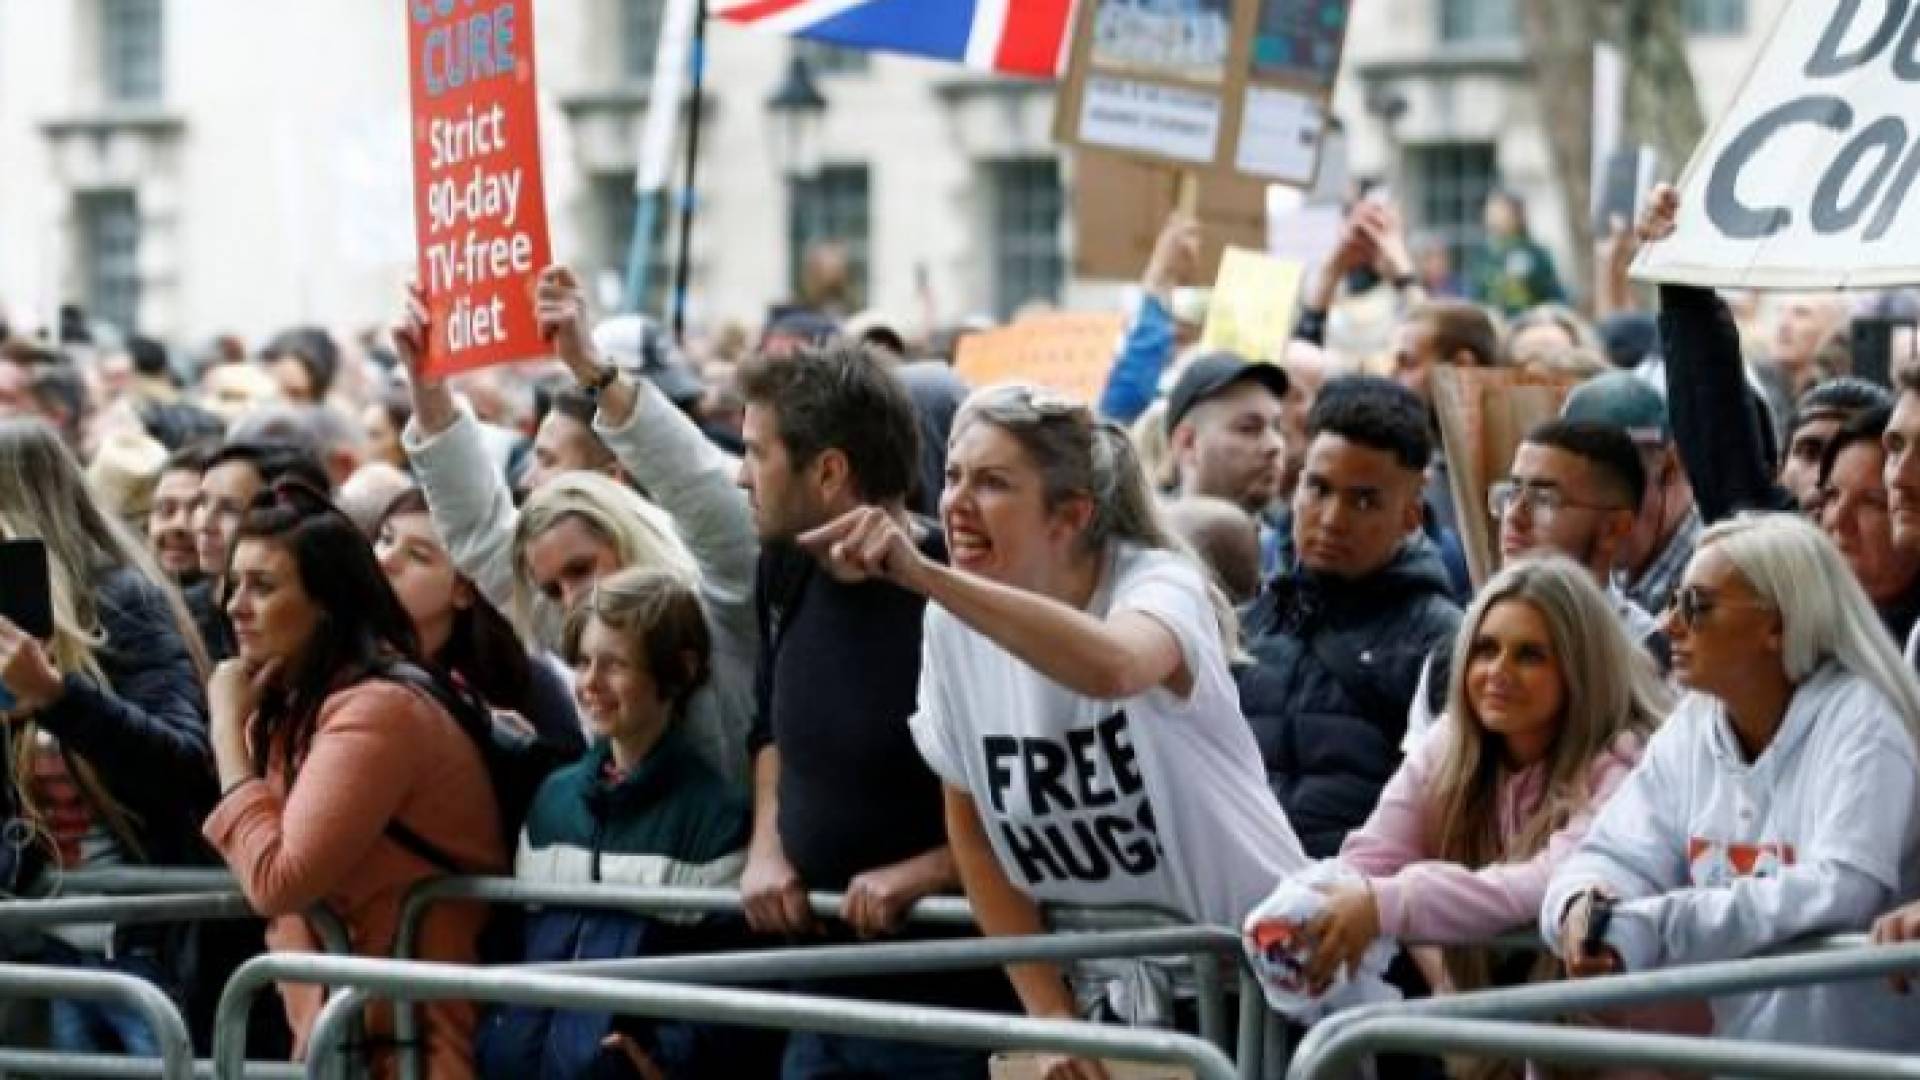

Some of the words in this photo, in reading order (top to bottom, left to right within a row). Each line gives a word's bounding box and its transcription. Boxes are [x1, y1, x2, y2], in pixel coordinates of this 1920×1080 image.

[423, 4, 515, 95] CURE
[430, 103, 505, 169] Strict
[428, 166, 522, 232] 90-day
[427, 230, 532, 295] TV-free
[448, 294, 506, 353] diet
[983, 710, 1143, 815] FREE
